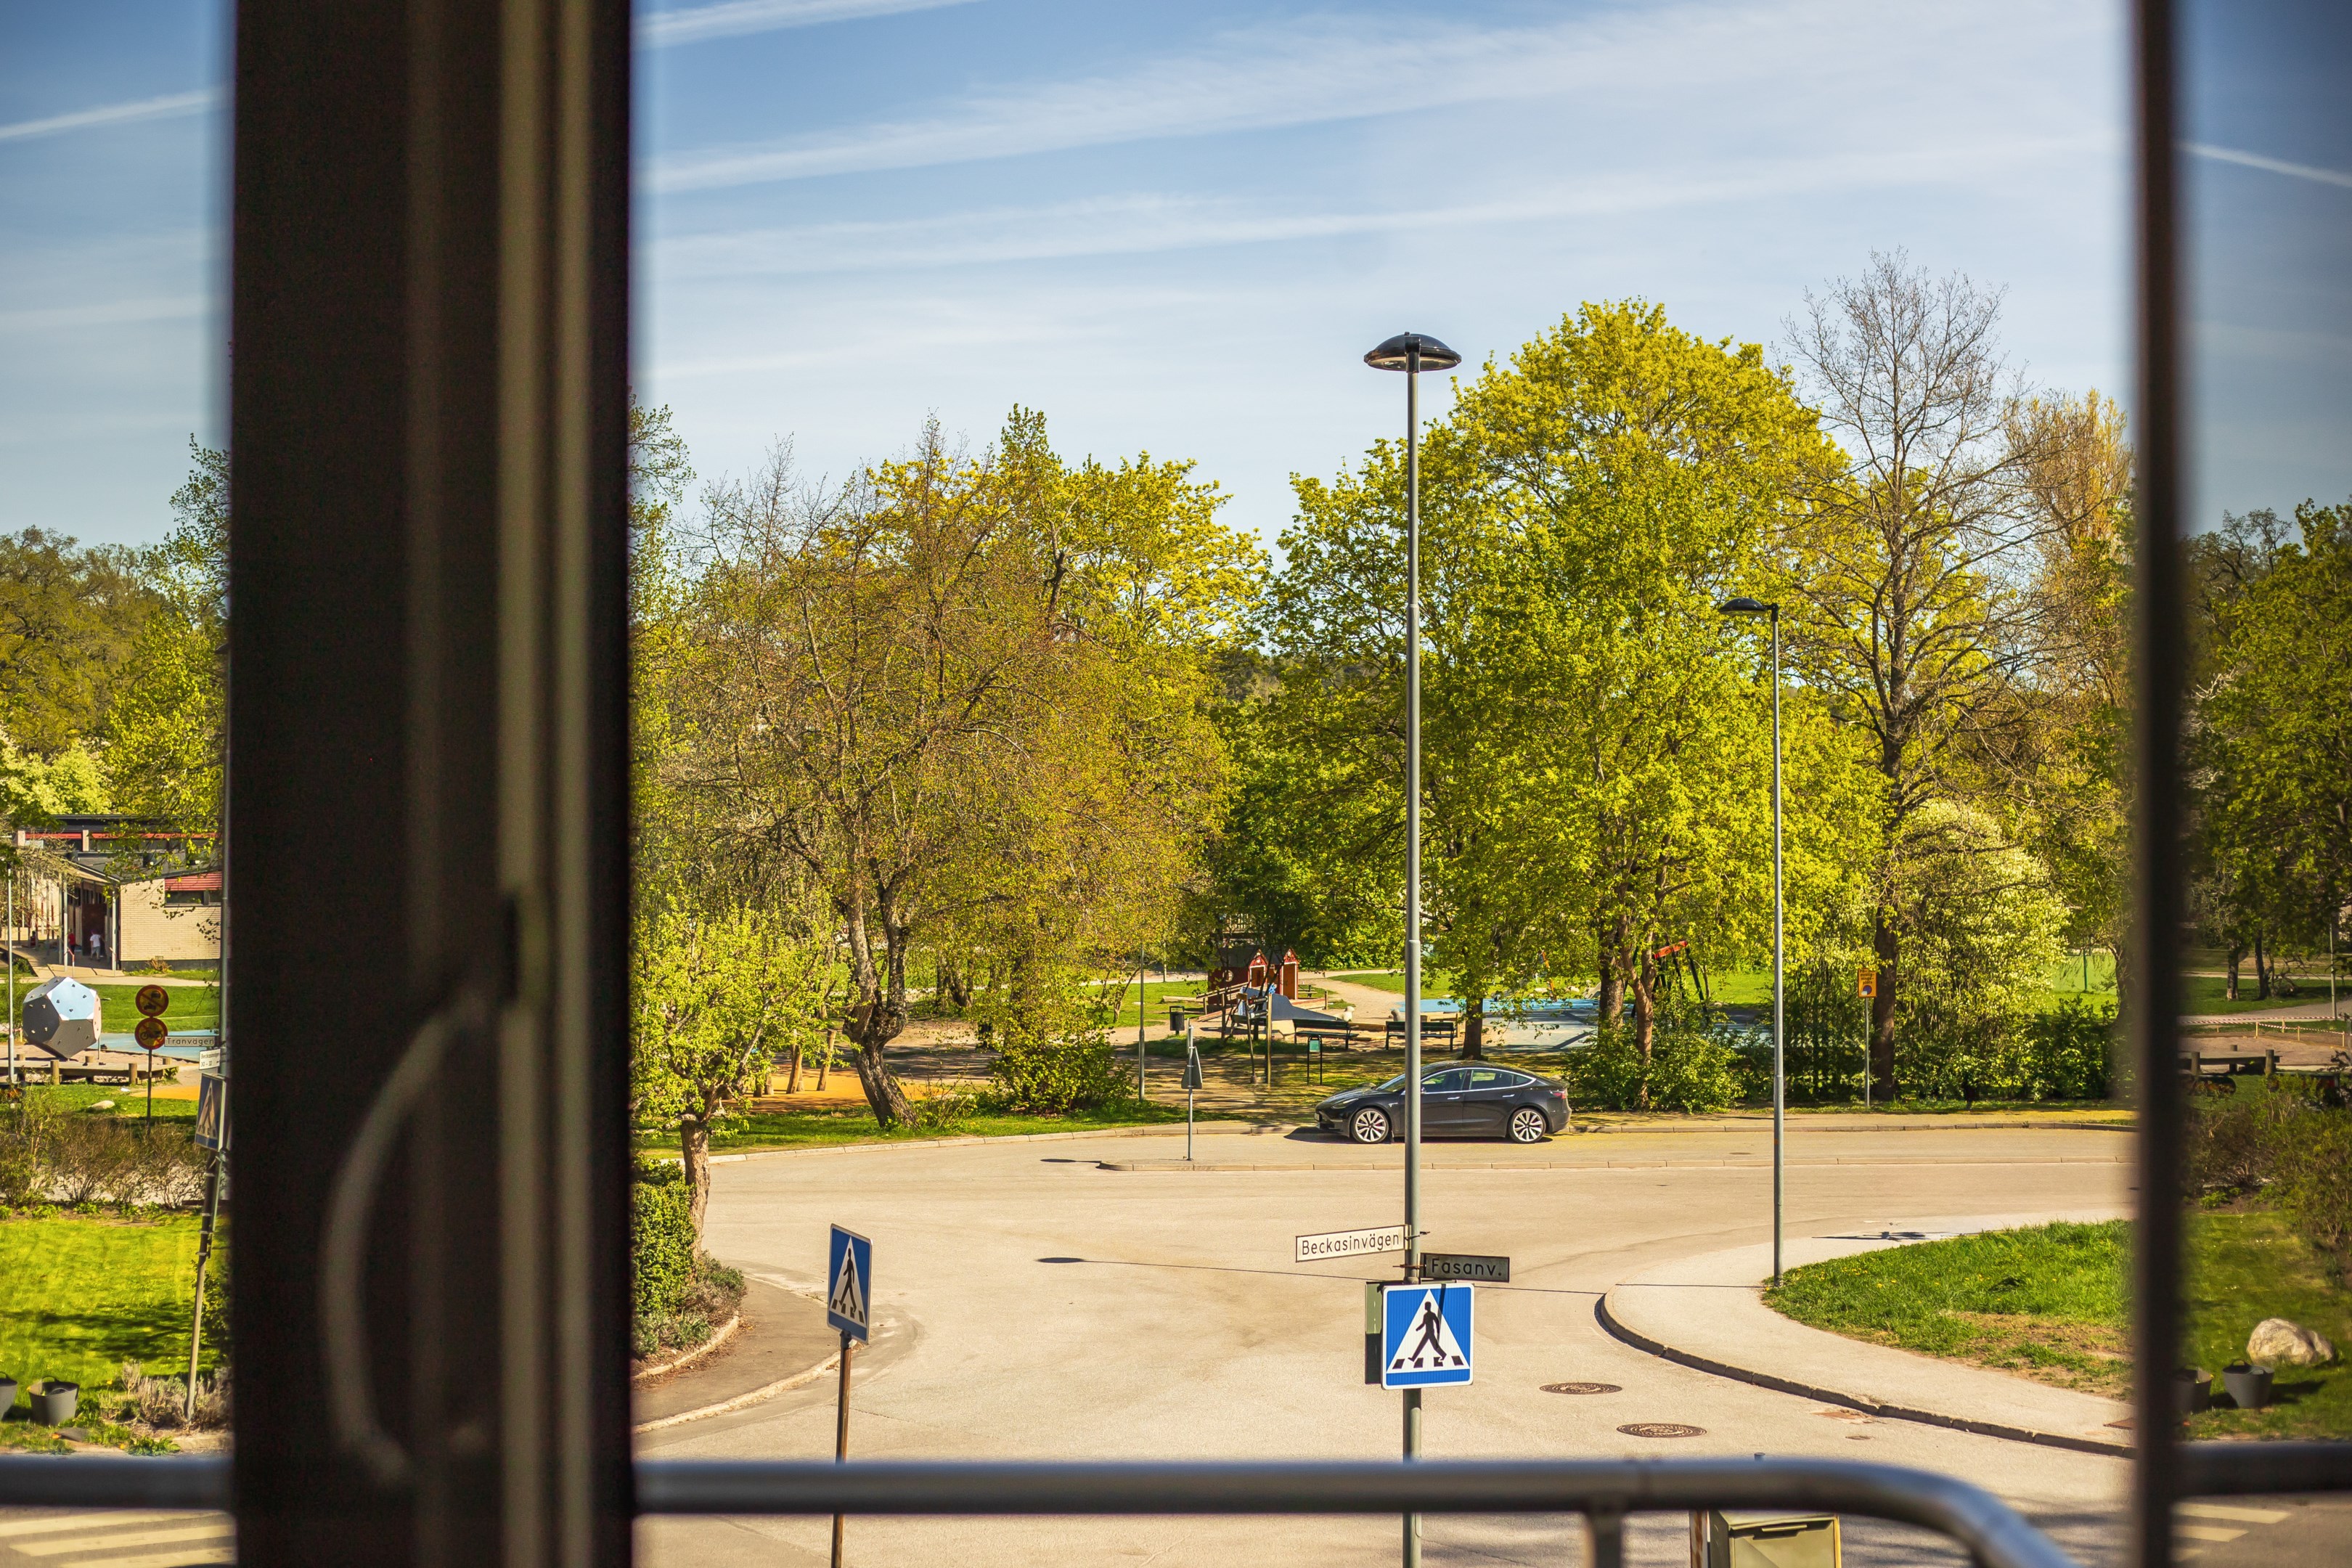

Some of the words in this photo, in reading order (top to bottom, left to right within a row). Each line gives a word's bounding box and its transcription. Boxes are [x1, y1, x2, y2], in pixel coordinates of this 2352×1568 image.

[166, 1037, 214, 1047] Tranvägen
[1302, 1233, 1399, 1255] Beckasinvägen
[1432, 1258, 1502, 1276] Fasanv.
